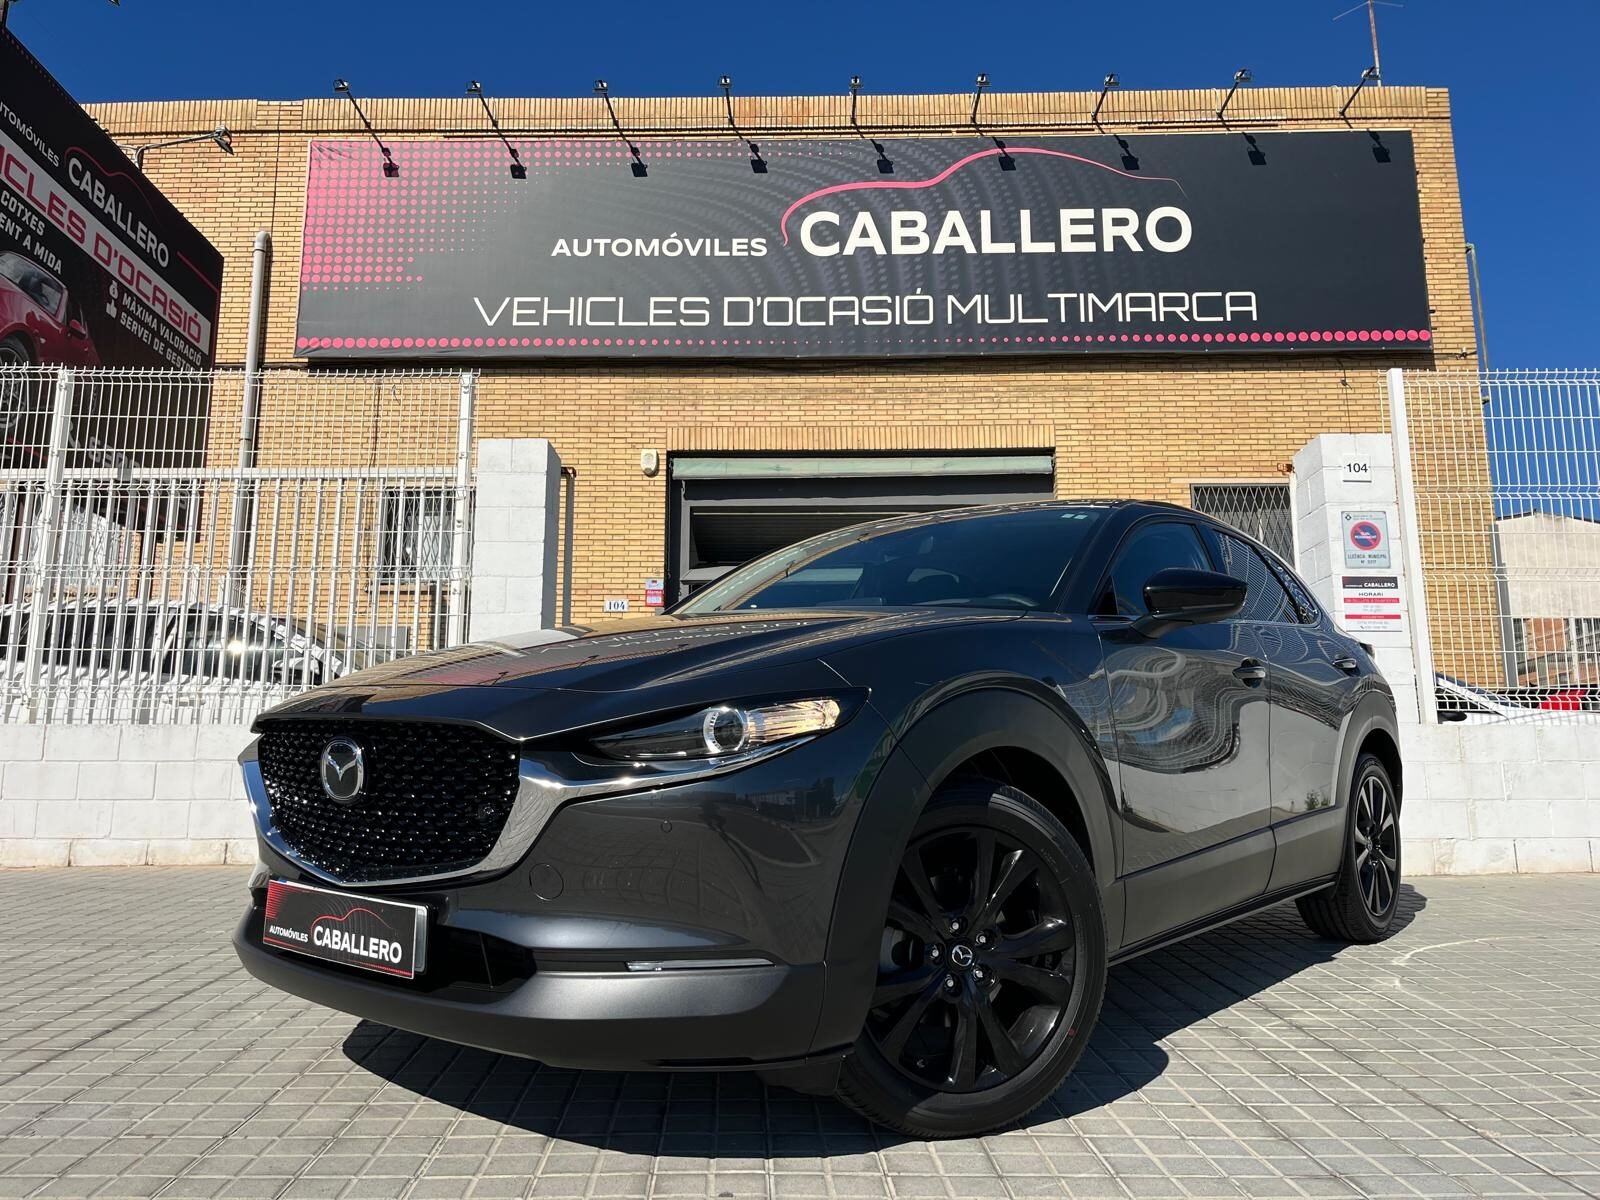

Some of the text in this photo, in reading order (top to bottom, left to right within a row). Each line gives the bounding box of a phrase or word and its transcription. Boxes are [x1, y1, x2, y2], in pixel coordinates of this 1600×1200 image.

[1, 190, 46, 236] COTXES
[68, 157, 170, 268] CABALLERO
[551, 206, 1193, 257] AUTOMÓVILES CABALLERO
[22, 234, 32, 250] A
[34, 241, 62, 275] MIDA
[93, 231, 202, 344] D'OCASIÓ
[473, 287, 1258, 327] VEHICLES D'OCASIÓ MULTIMARCA
[120, 311, 152, 345] SERVEI
[153, 337, 165, 355] DE
[122, 292, 202, 366] MÀXIMA VALORACIÓ
[1346, 462, 1368, 473] 104
[608, 601, 625, 611] 104
[268, 925, 403, 964] AUTOMÓVILES CABALLERO
